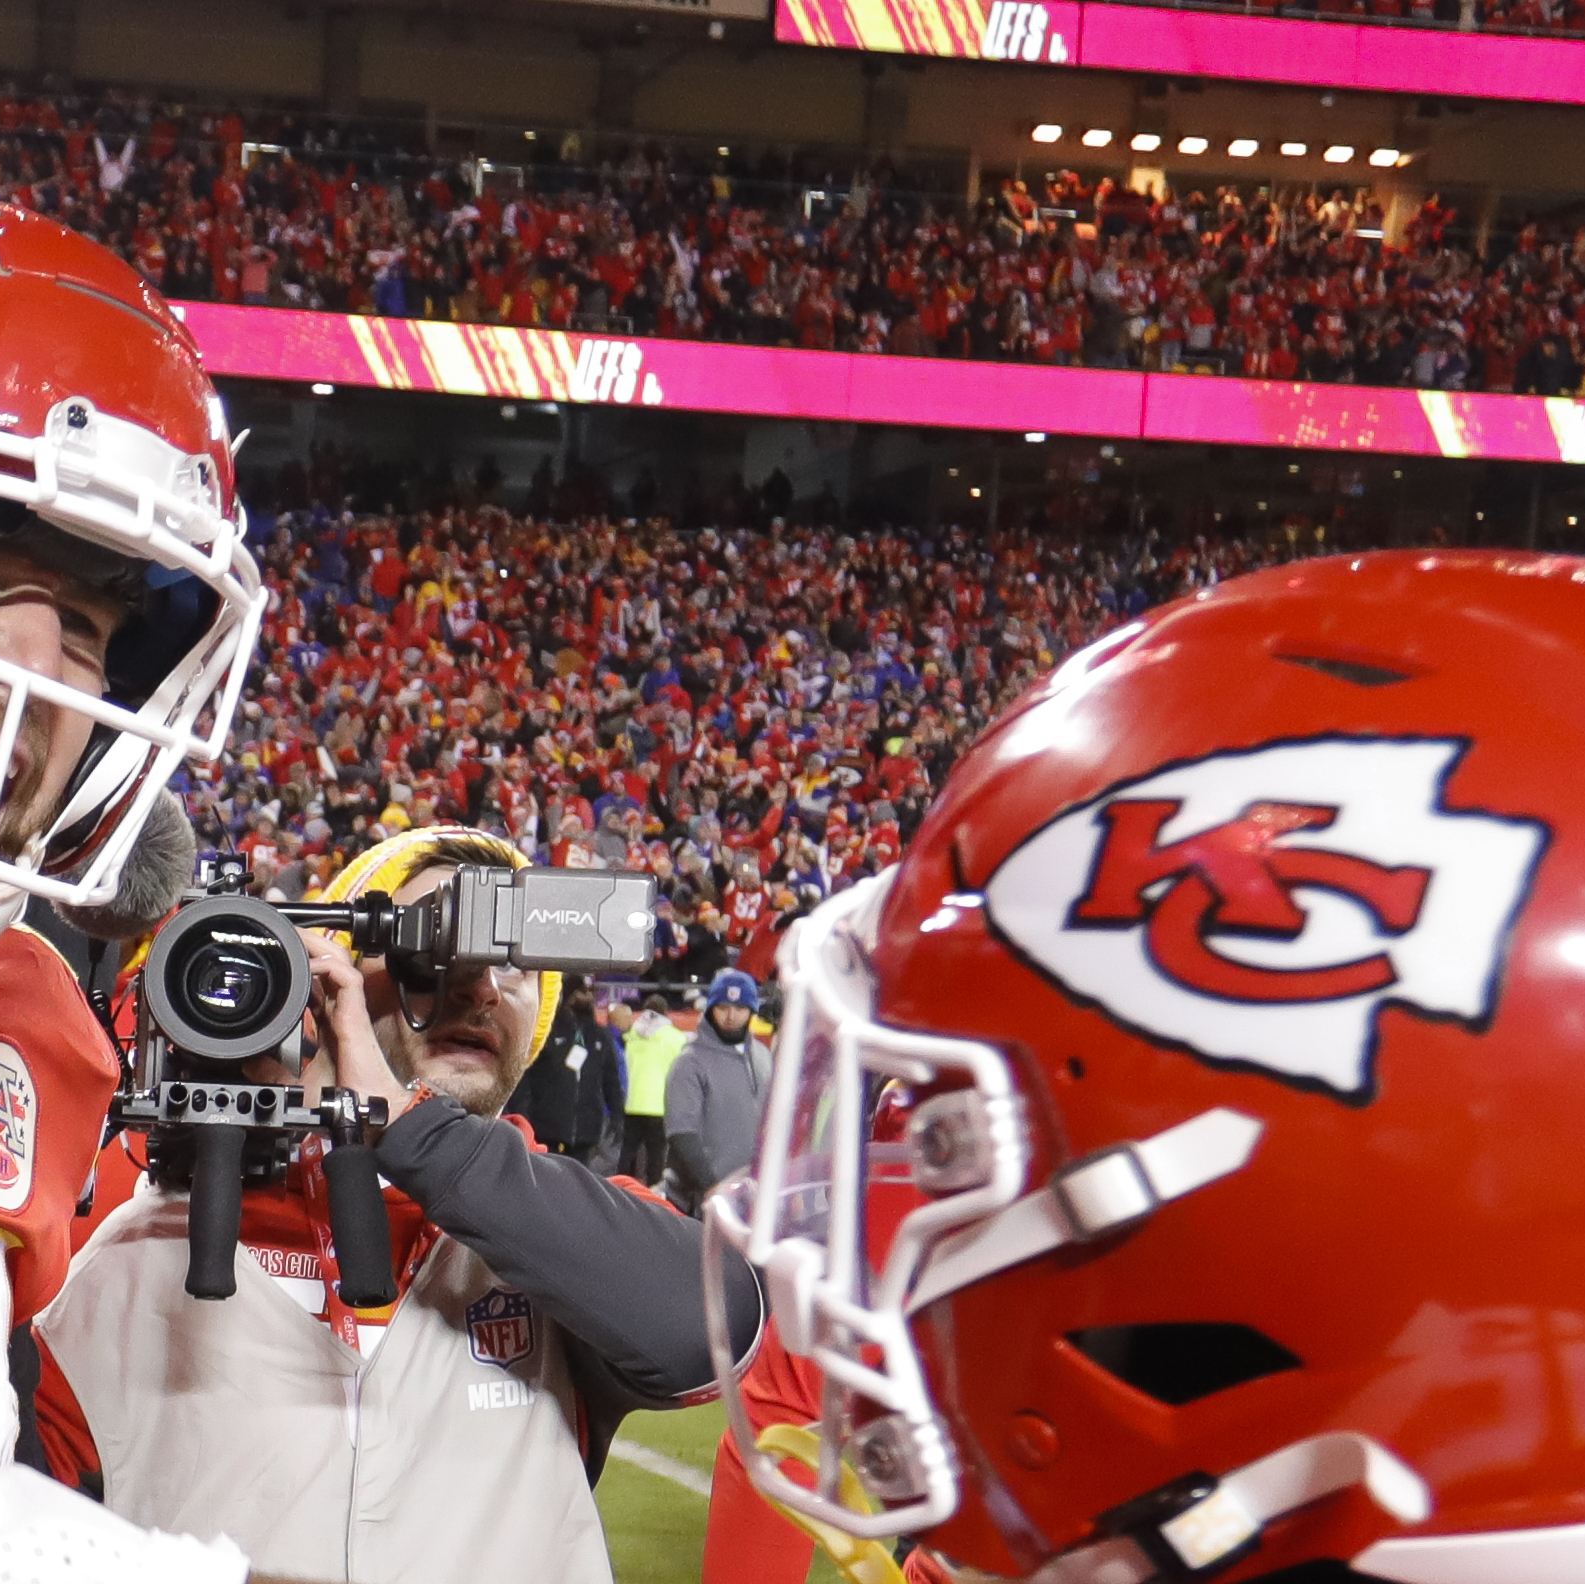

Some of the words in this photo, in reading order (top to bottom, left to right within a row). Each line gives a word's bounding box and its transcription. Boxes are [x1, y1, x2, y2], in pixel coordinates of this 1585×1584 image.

[526, 908, 595, 926] AMIRA
[1062, 795, 1433, 1007] KC
[475, 1318, 530, 1360] NFL
